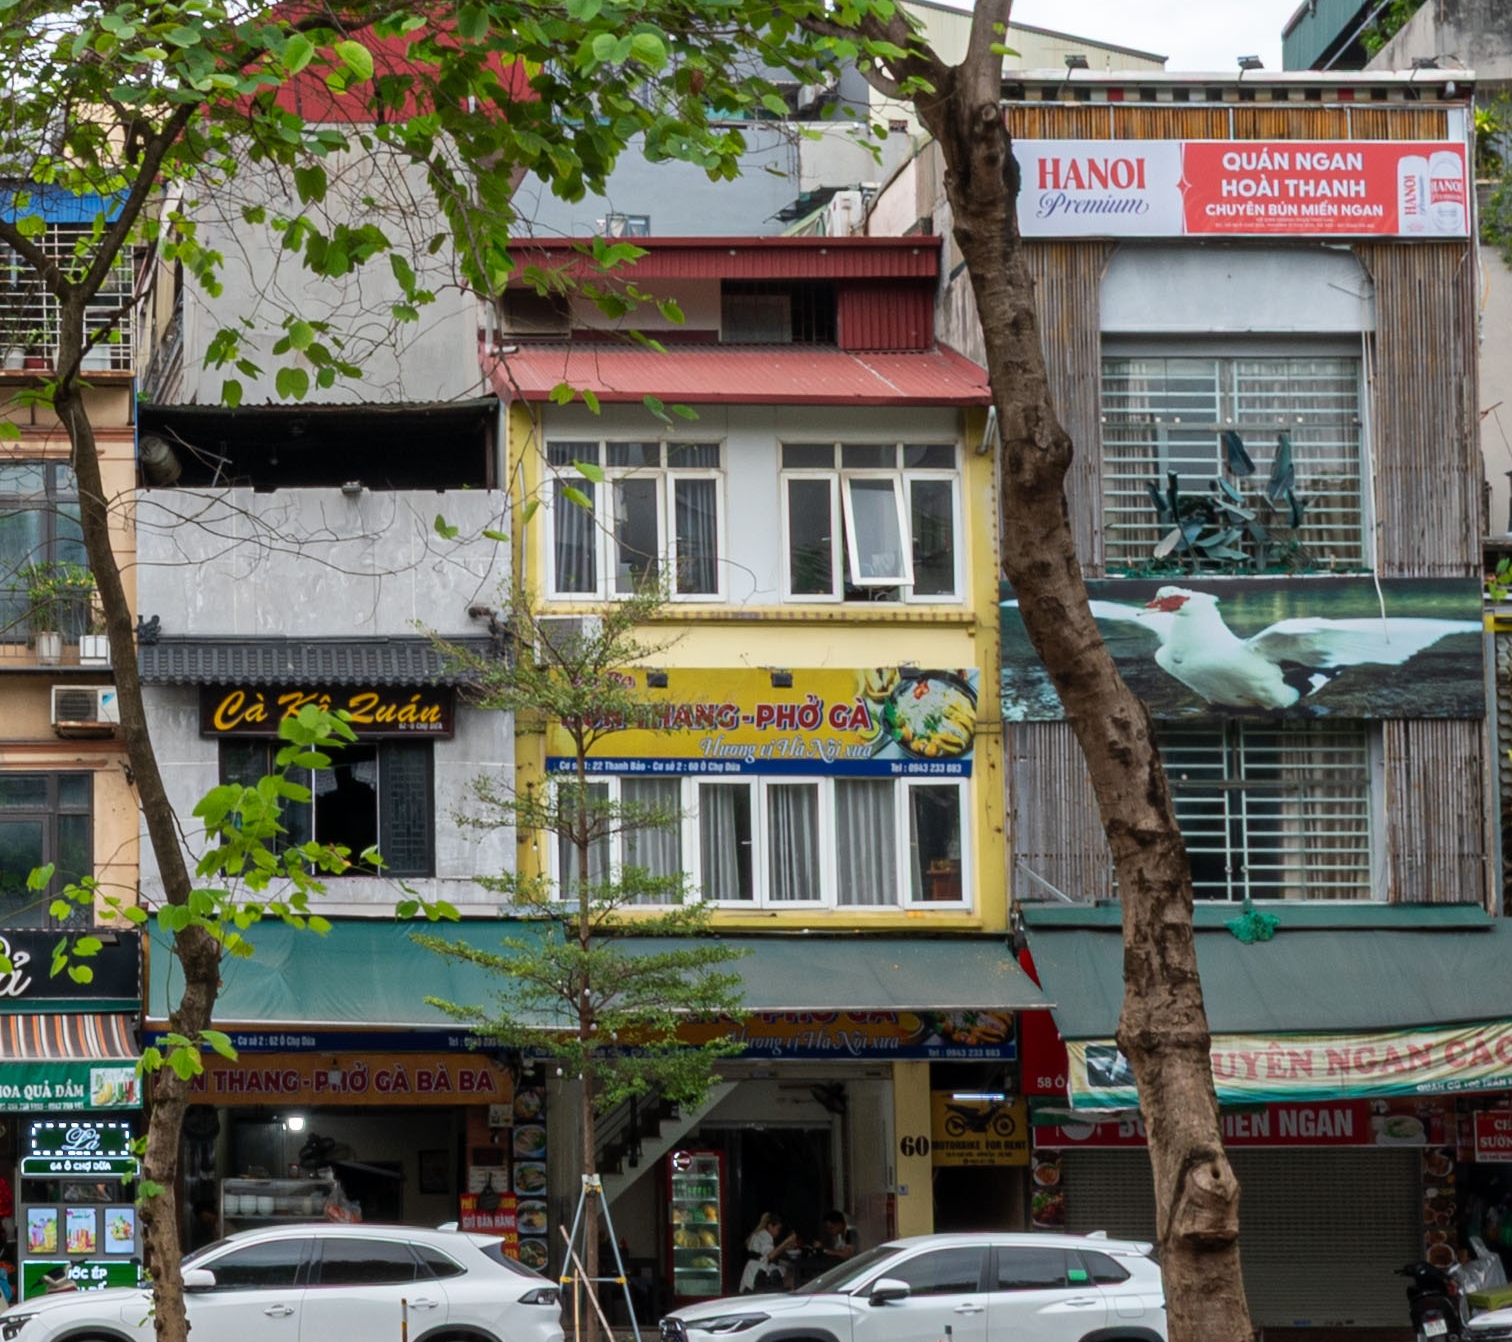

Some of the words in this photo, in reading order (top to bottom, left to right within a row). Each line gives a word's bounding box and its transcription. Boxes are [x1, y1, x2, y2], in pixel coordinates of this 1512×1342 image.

[1222, 147, 1292, 173] QUÁN
[1296, 152, 1363, 171] NGAN
[1037, 158, 1146, 190] HANOI
[1221, 174, 1280, 198] HOÀI
[1285, 179, 1366, 198] THANH
[1036, 192, 1150, 219] Premium
[1205, 201, 1266, 216] CHUYÊN
[1269, 200, 1300, 216] BÚN
[1302, 199, 1339, 216] MIẾN
[1341, 204, 1383, 216] NGAN
[214, 690, 268, 731] Cà
[349, 692, 442, 725] Quán
[828, 691, 875, 731] GÀ
[699, 736, 758, 764] Hương
[775, 736, 804, 758] Hà
[805, 738, 843, 761] Nội
[604, 761, 629, 771] Thanh
[1212, 1041, 1314, 1081] UYÊN
[1326, 1043, 1434, 1078] NGAN
[24, 1080, 53, 1101] QUẢ
[375, 1063, 409, 1094] GÀ
[416, 1063, 453, 1093] BÀ
[458, 1069, 495, 1093] BA
[1037, 1076, 1052, 1089] 58
[1279, 1109, 1354, 1137] NGAN
[899, 1135, 930, 1157] 60
